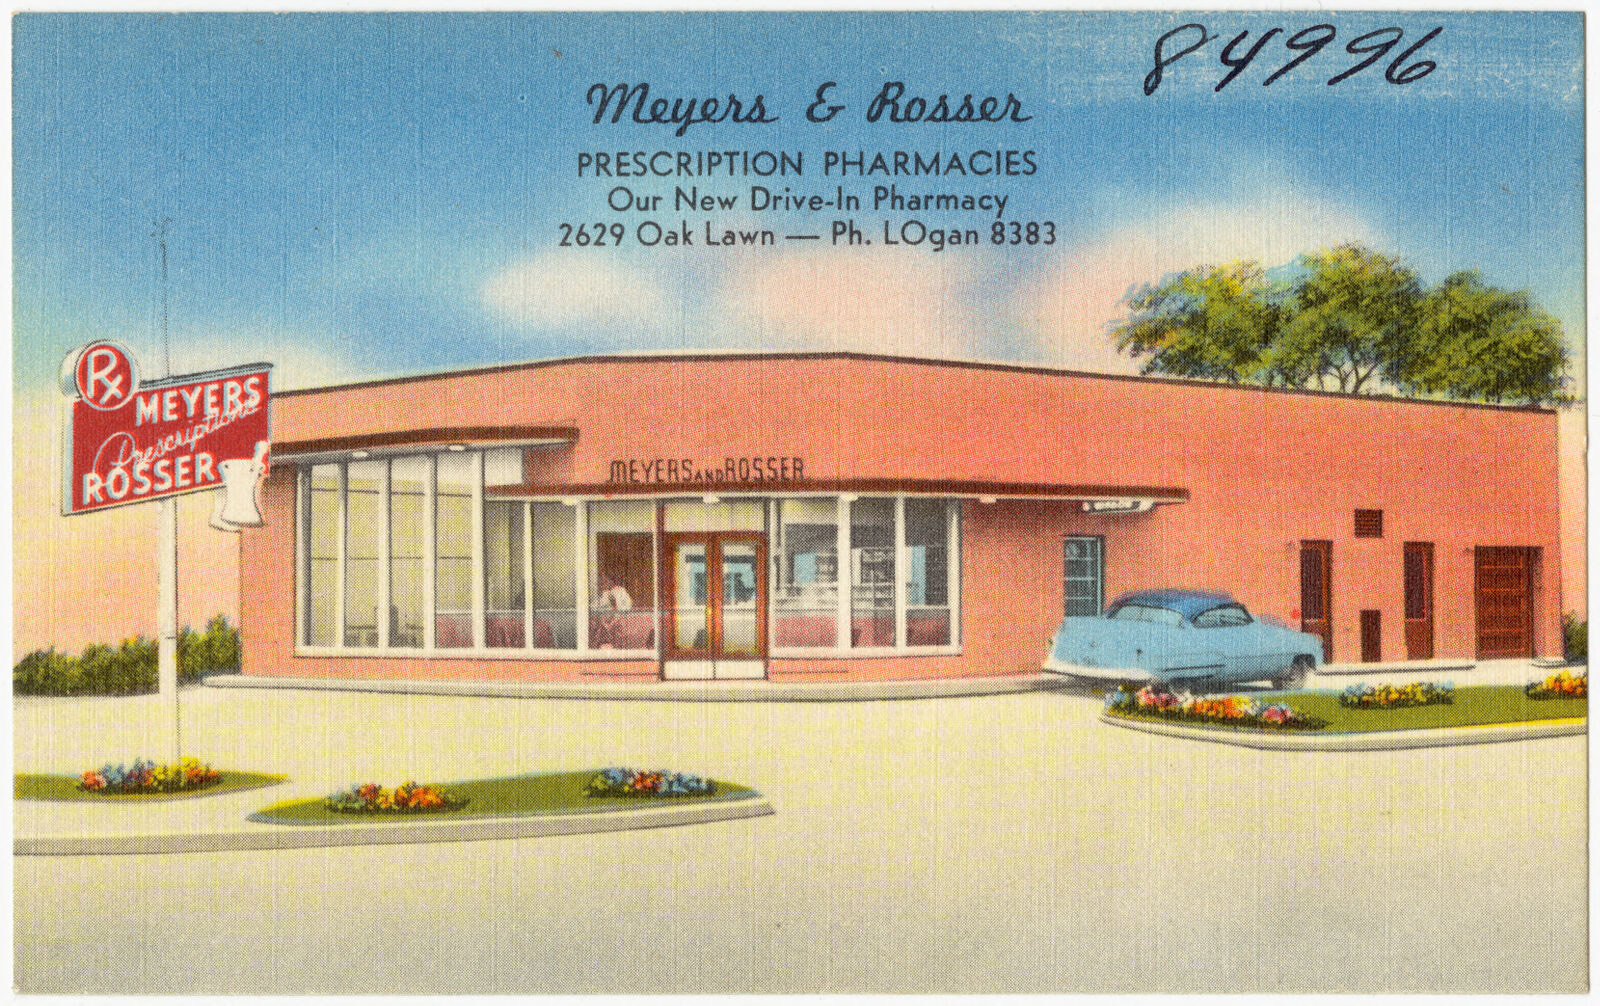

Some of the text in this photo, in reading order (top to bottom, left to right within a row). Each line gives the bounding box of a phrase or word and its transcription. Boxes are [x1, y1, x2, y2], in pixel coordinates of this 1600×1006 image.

[1144, 23, 1443, 96] 84996
[135, 376, 261, 427] MEYERS
[82, 452, 216, 505] ROSSER
[609, 457, 804, 482] MEYERS AND ROSSER
